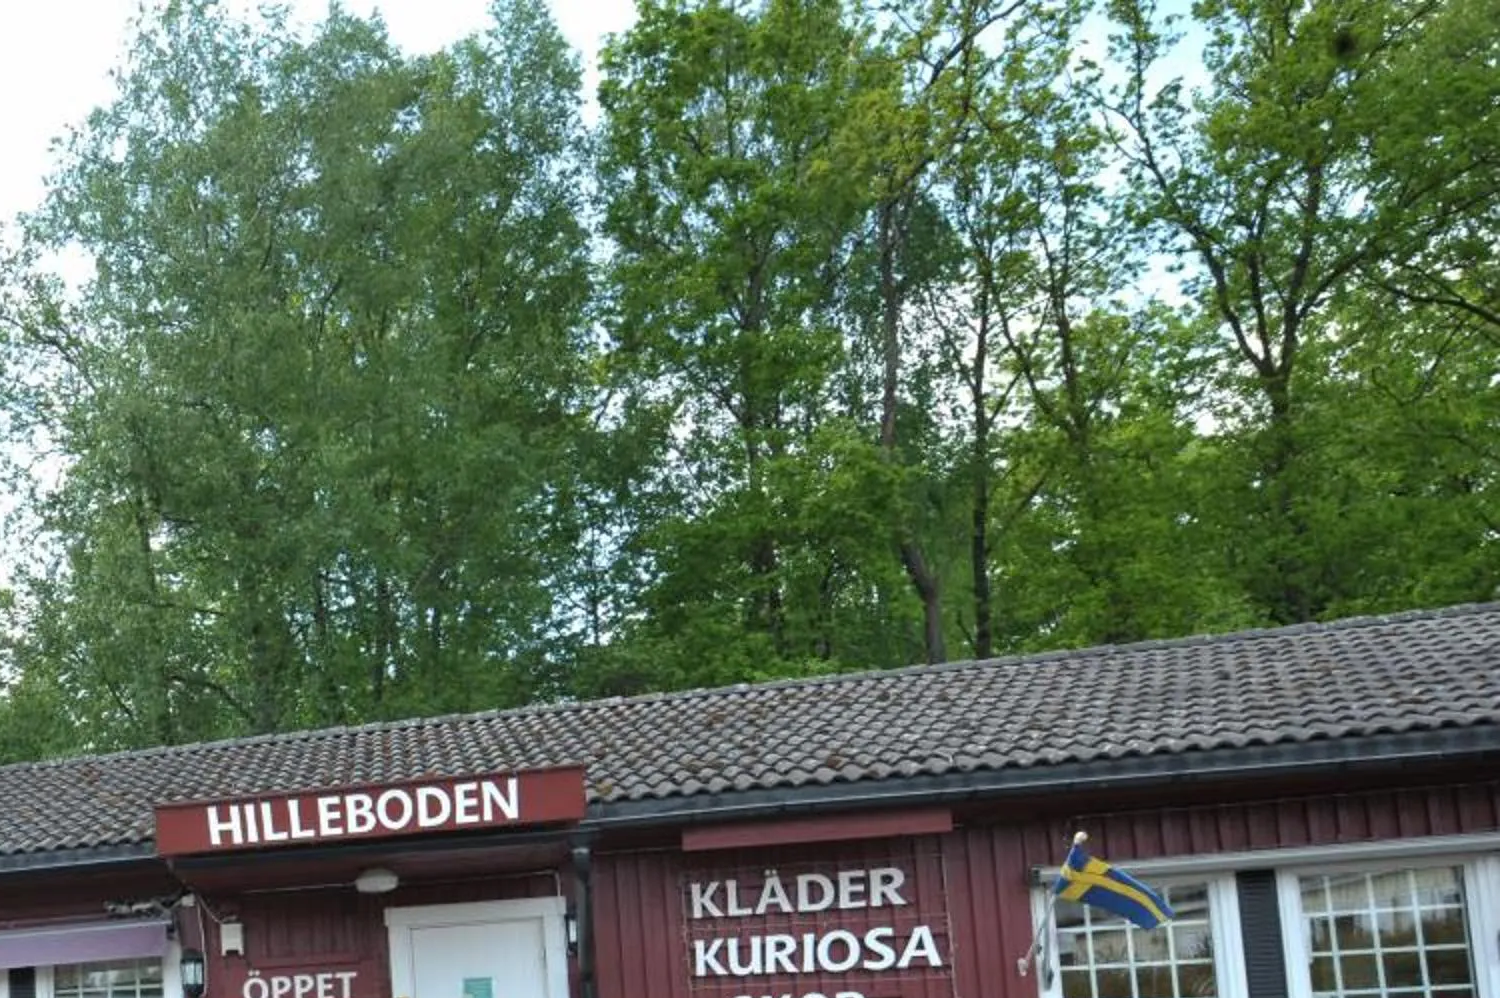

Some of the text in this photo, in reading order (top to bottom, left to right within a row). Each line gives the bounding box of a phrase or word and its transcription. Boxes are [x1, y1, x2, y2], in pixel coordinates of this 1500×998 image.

[206, 777, 520, 846] HILLEBODEN
[690, 867, 906, 919] KLÄDER
[694, 925, 943, 977] KURIOSA
